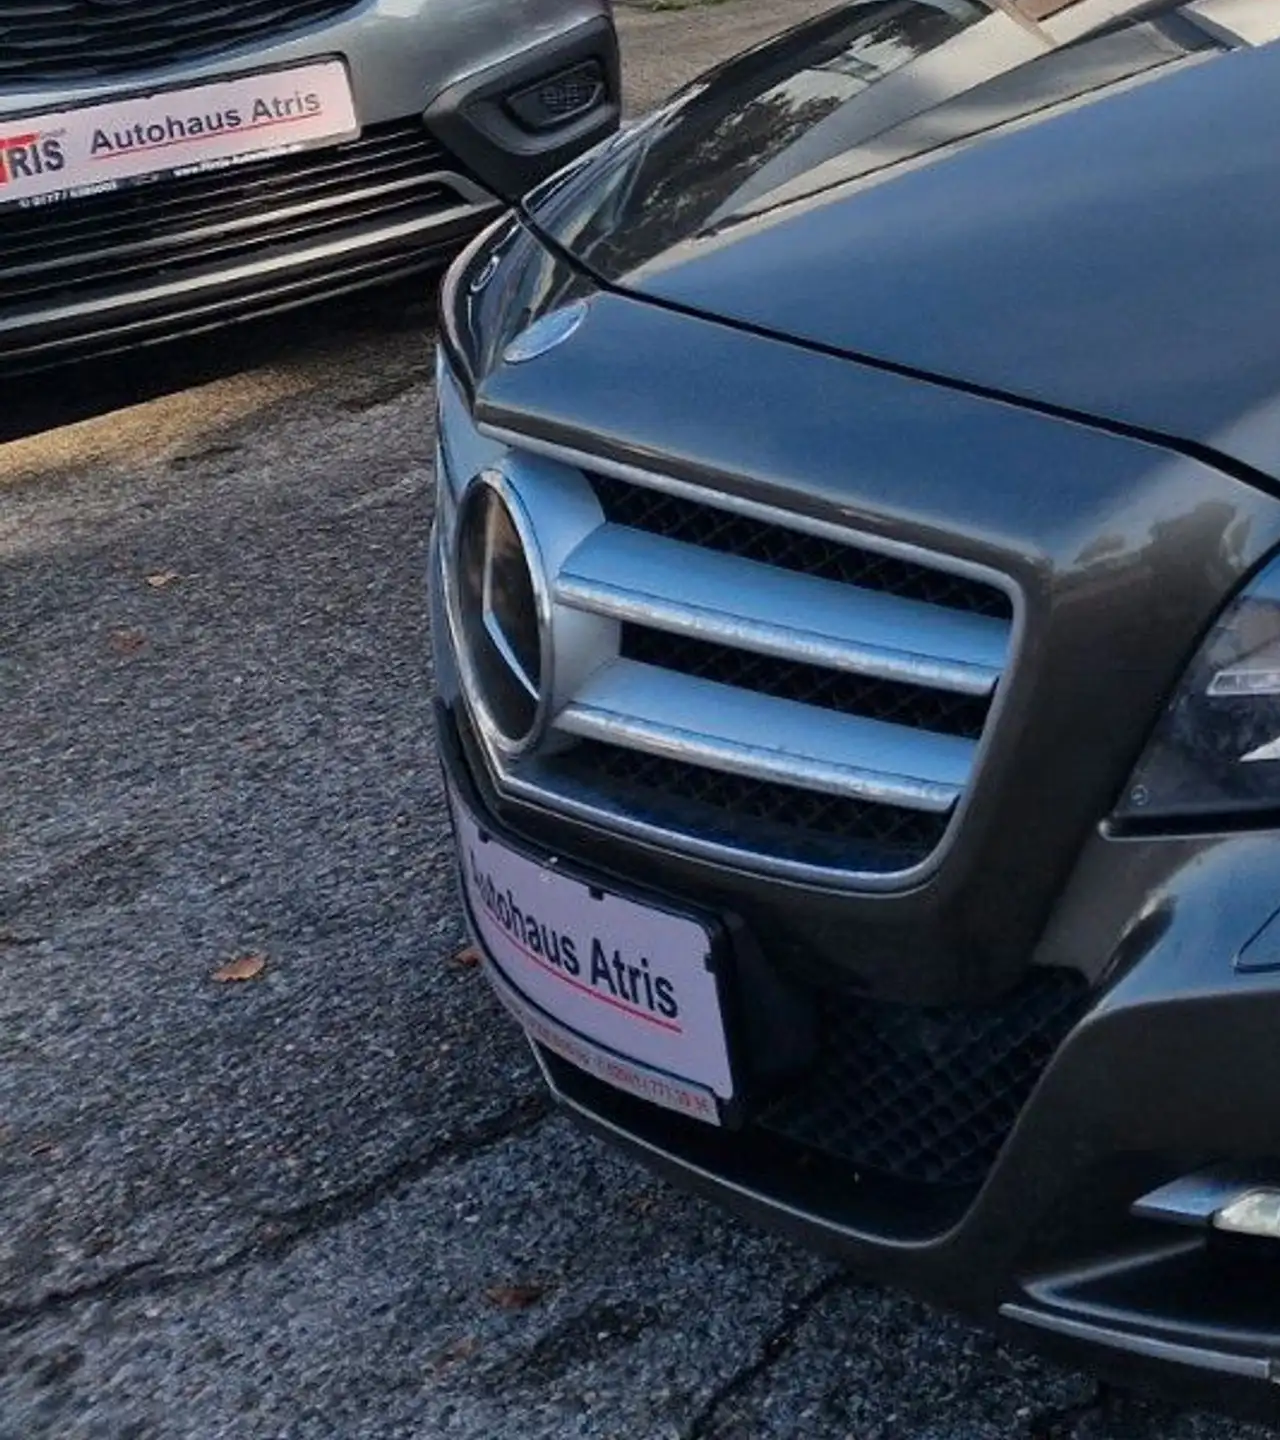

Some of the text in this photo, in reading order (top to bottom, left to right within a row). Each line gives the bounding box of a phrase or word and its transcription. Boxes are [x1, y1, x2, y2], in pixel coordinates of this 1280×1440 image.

[90, 90, 322, 155] Autohaus Atris
[589, 936, 679, 1019] Atris
